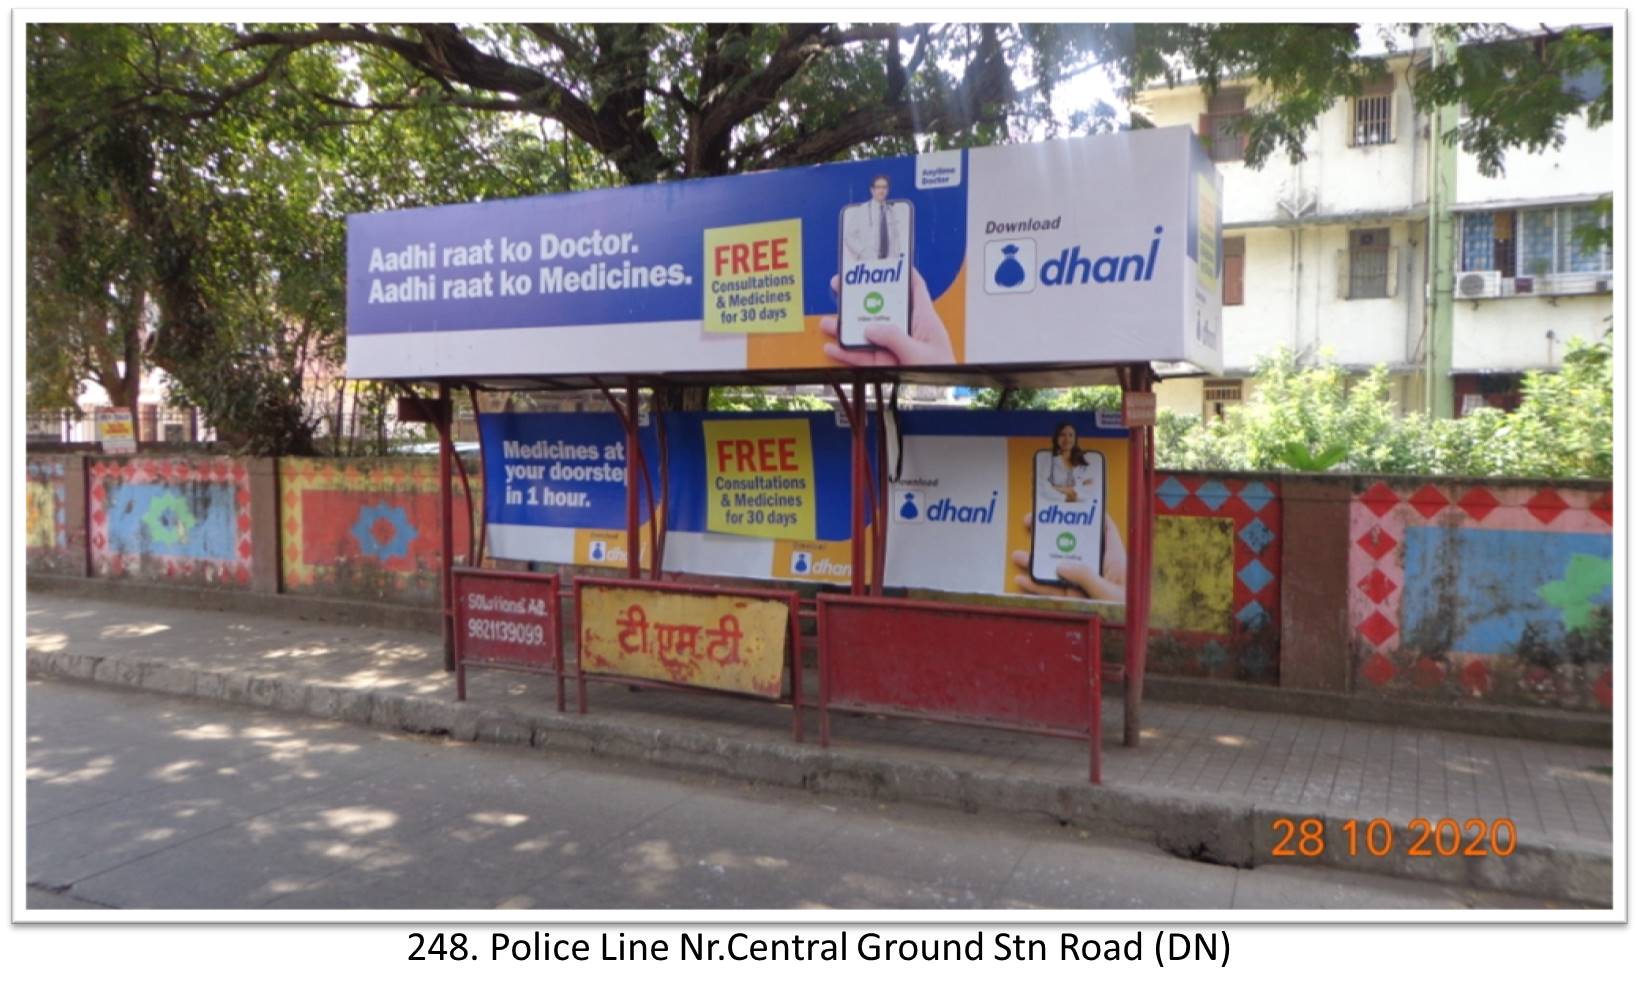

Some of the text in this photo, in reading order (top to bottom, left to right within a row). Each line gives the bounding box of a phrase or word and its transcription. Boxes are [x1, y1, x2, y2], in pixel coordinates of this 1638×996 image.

[985, 216, 1062, 235] Download
[368, 229, 639, 273] Aadhi raat ko Doctor.
[714, 237, 789, 277] FREE
[1039, 224, 1163, 287] dhani
[845, 253, 905, 285] dhani
[368, 260, 693, 304] Aadhi raat ko Medicines.
[711, 274, 796, 293] Consultations
[716, 290, 791, 309] & Medicines
[721, 306, 787, 323] for 30 days
[503, 440, 625, 460] Medicines at
[716, 437, 800, 473] FREE
[504, 463, 546, 483] your
[714, 475, 807, 491] Consultations
[506, 485, 592, 508] in 1 hour.
[720, 493, 803, 508] & Medicines
[725, 509, 798, 527] for 30 days
[926, 491, 999, 525] dhani
[1038, 499, 1099, 526] dhani
